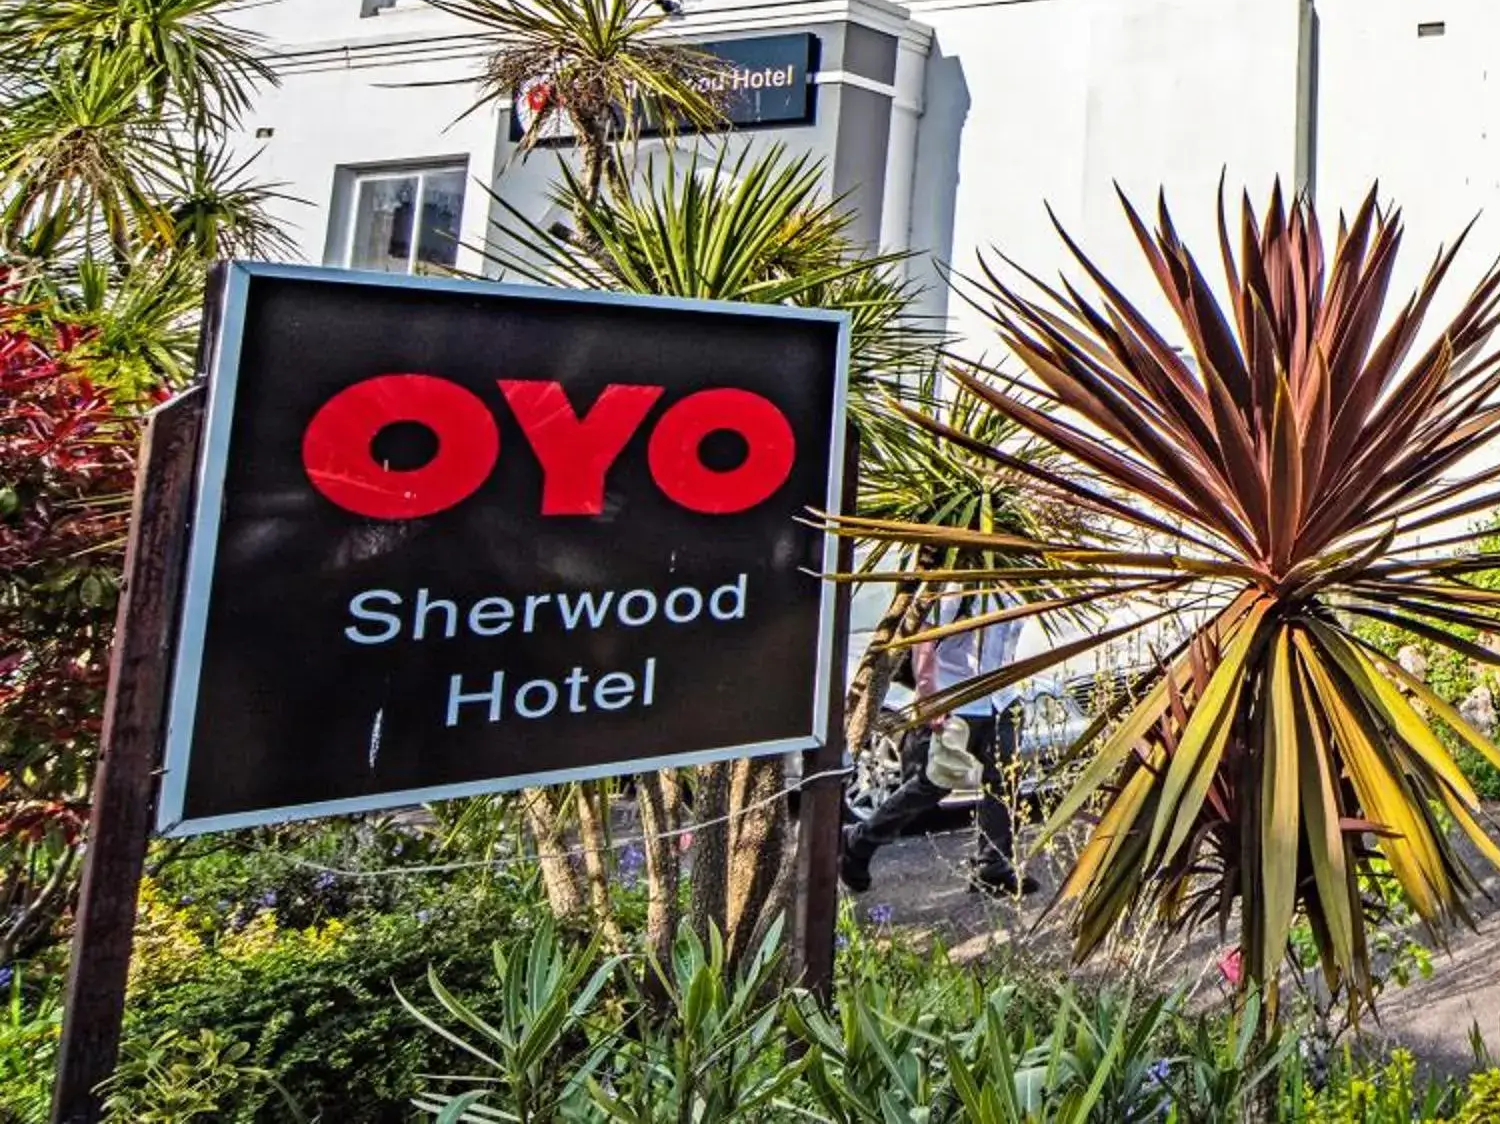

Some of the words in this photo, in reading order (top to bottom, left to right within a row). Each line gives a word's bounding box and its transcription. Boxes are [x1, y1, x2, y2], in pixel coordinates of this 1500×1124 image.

[732, 63, 794, 90] Hotel
[303, 373, 795, 519] OYO
[344, 573, 748, 645] Sherwood
[445, 657, 657, 727] Hotel
